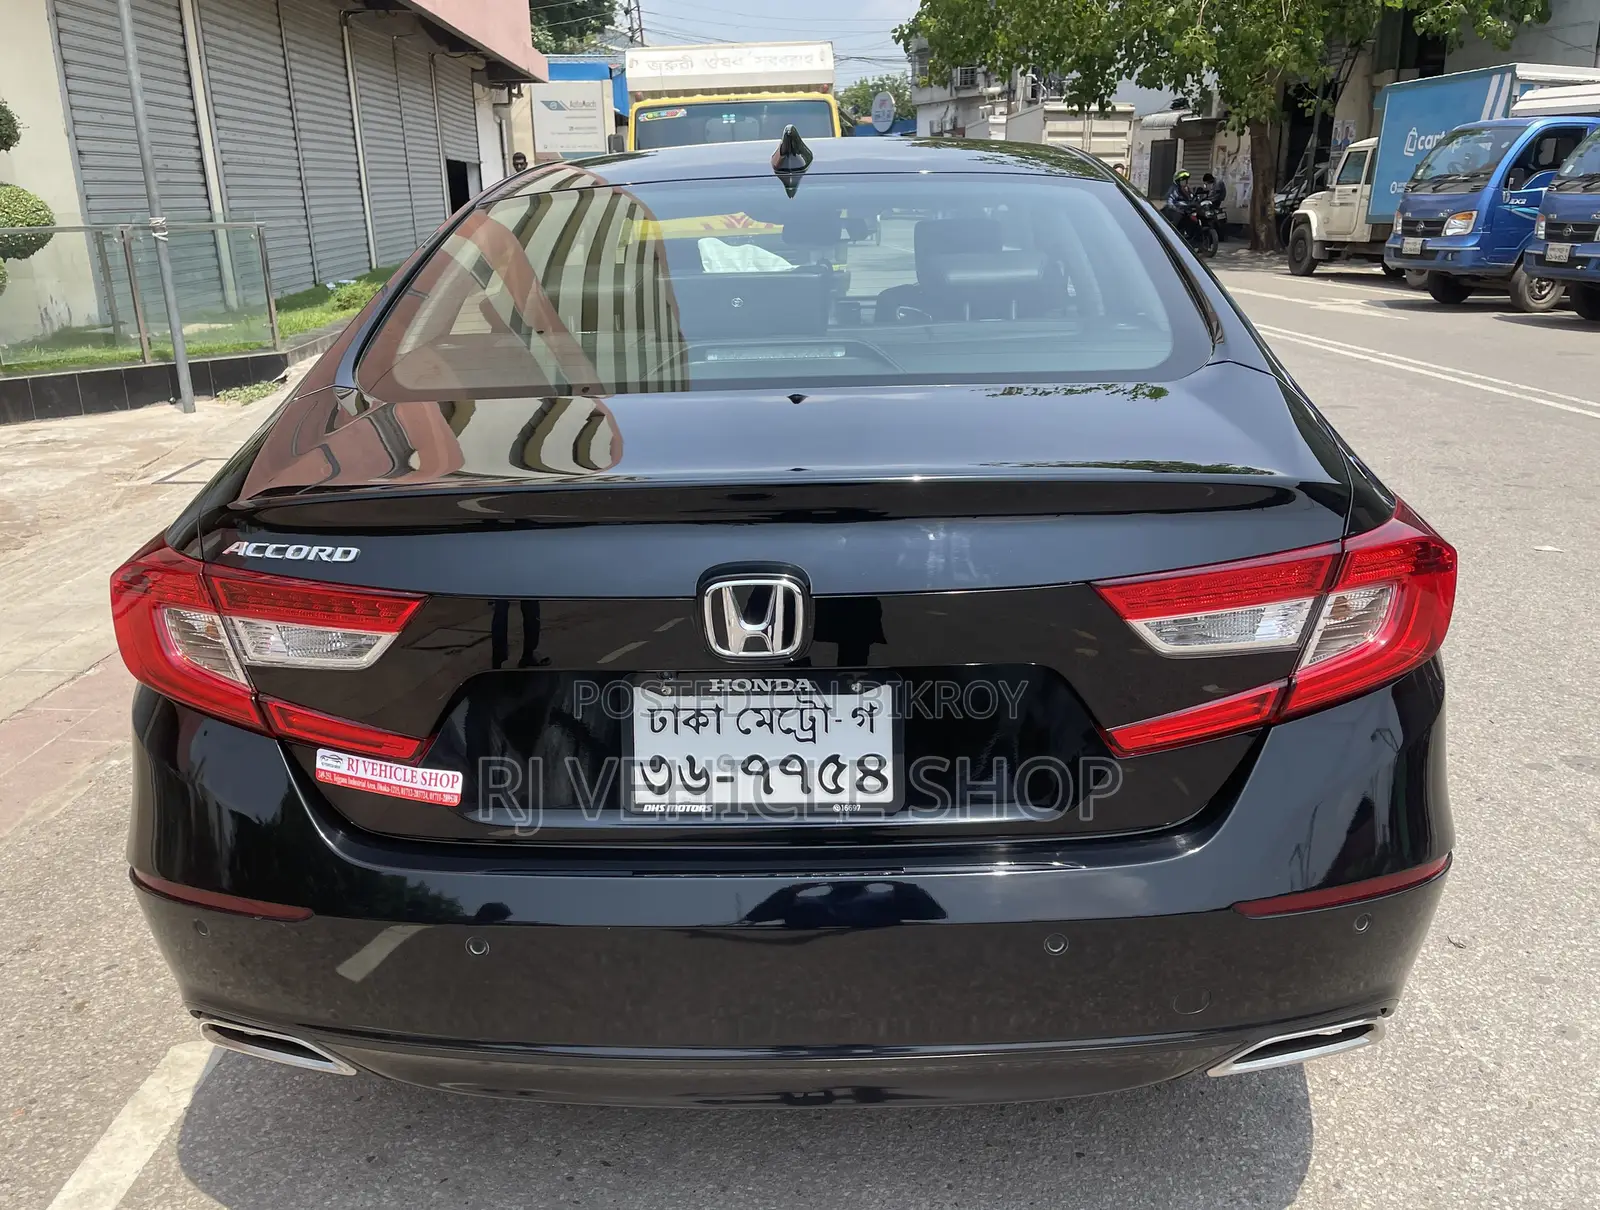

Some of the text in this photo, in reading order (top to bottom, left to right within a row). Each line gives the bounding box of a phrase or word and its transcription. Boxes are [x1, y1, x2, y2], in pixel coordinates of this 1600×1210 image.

[222, 541, 360, 562] ACCORD
[709, 678, 816, 692] HONDA
[647, 704, 724, 735] ঢাকা
[346, 757, 460, 789] RJ VEHICLE SHOP
[640, 753, 890, 796] ৩৬-৭৭৫৪
[642, 804, 713, 812] DHS MOTORS
